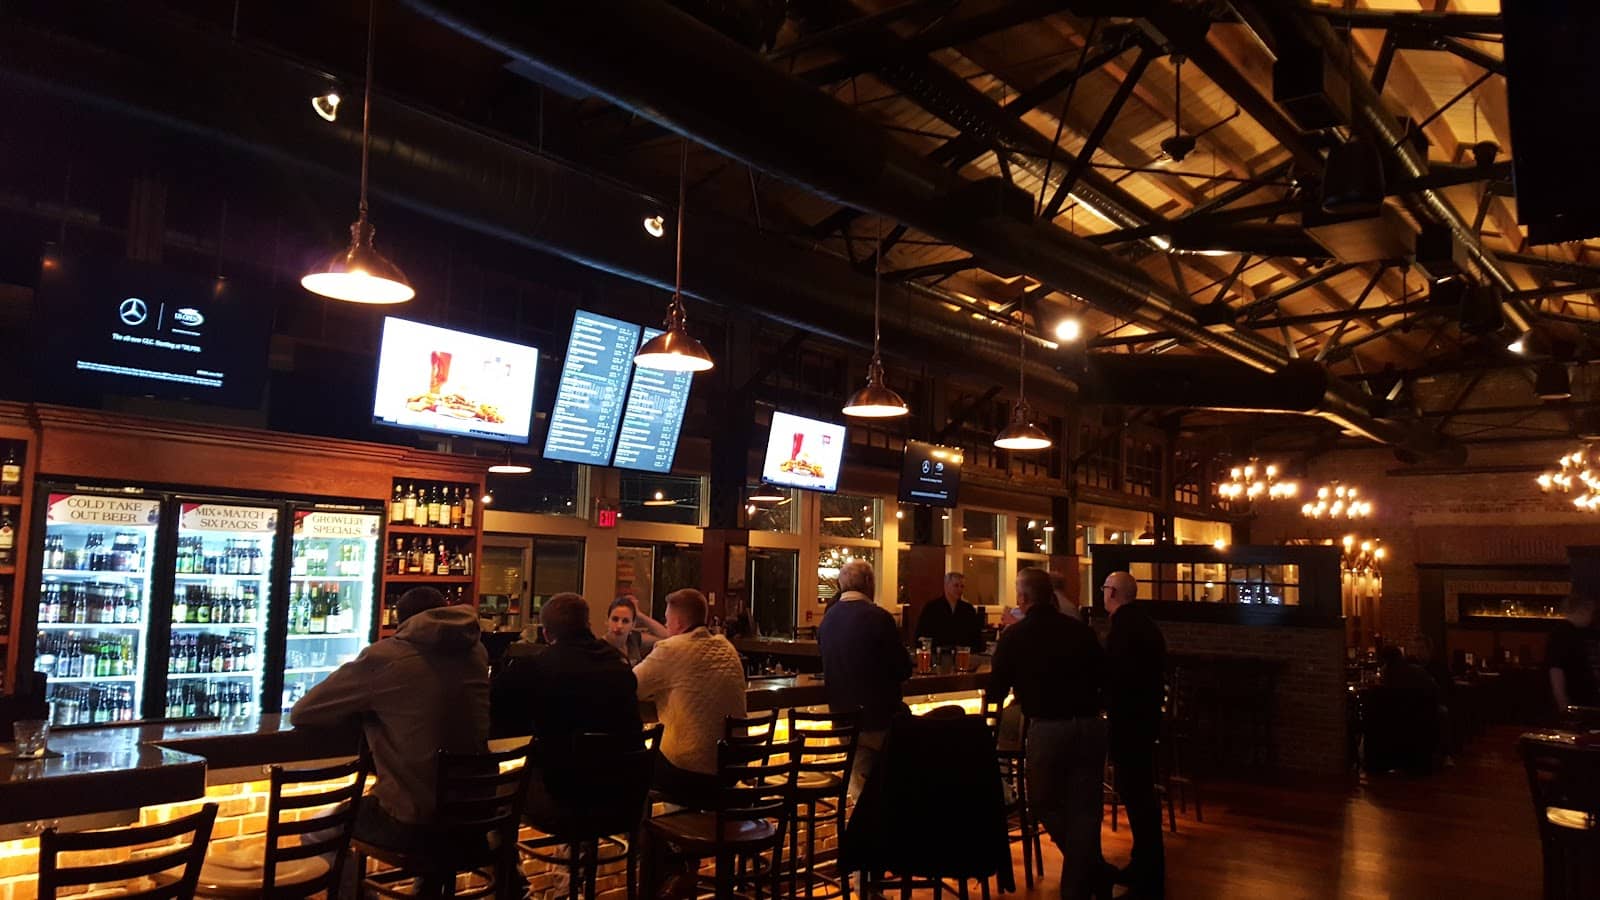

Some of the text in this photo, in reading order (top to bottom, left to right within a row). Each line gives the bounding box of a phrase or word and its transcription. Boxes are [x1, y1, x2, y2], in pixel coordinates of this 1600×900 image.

[67, 498, 142, 511] COLD TAKE
[70, 510, 137, 522] OUT BEER
[195, 507, 264, 519] MIX MATCH
[599, 510, 616, 527] EXIT
[200, 518, 259, 529] SIX PACKS
[312, 515, 363, 525] GROWLER
[313, 525, 361, 535] SPECIALS
